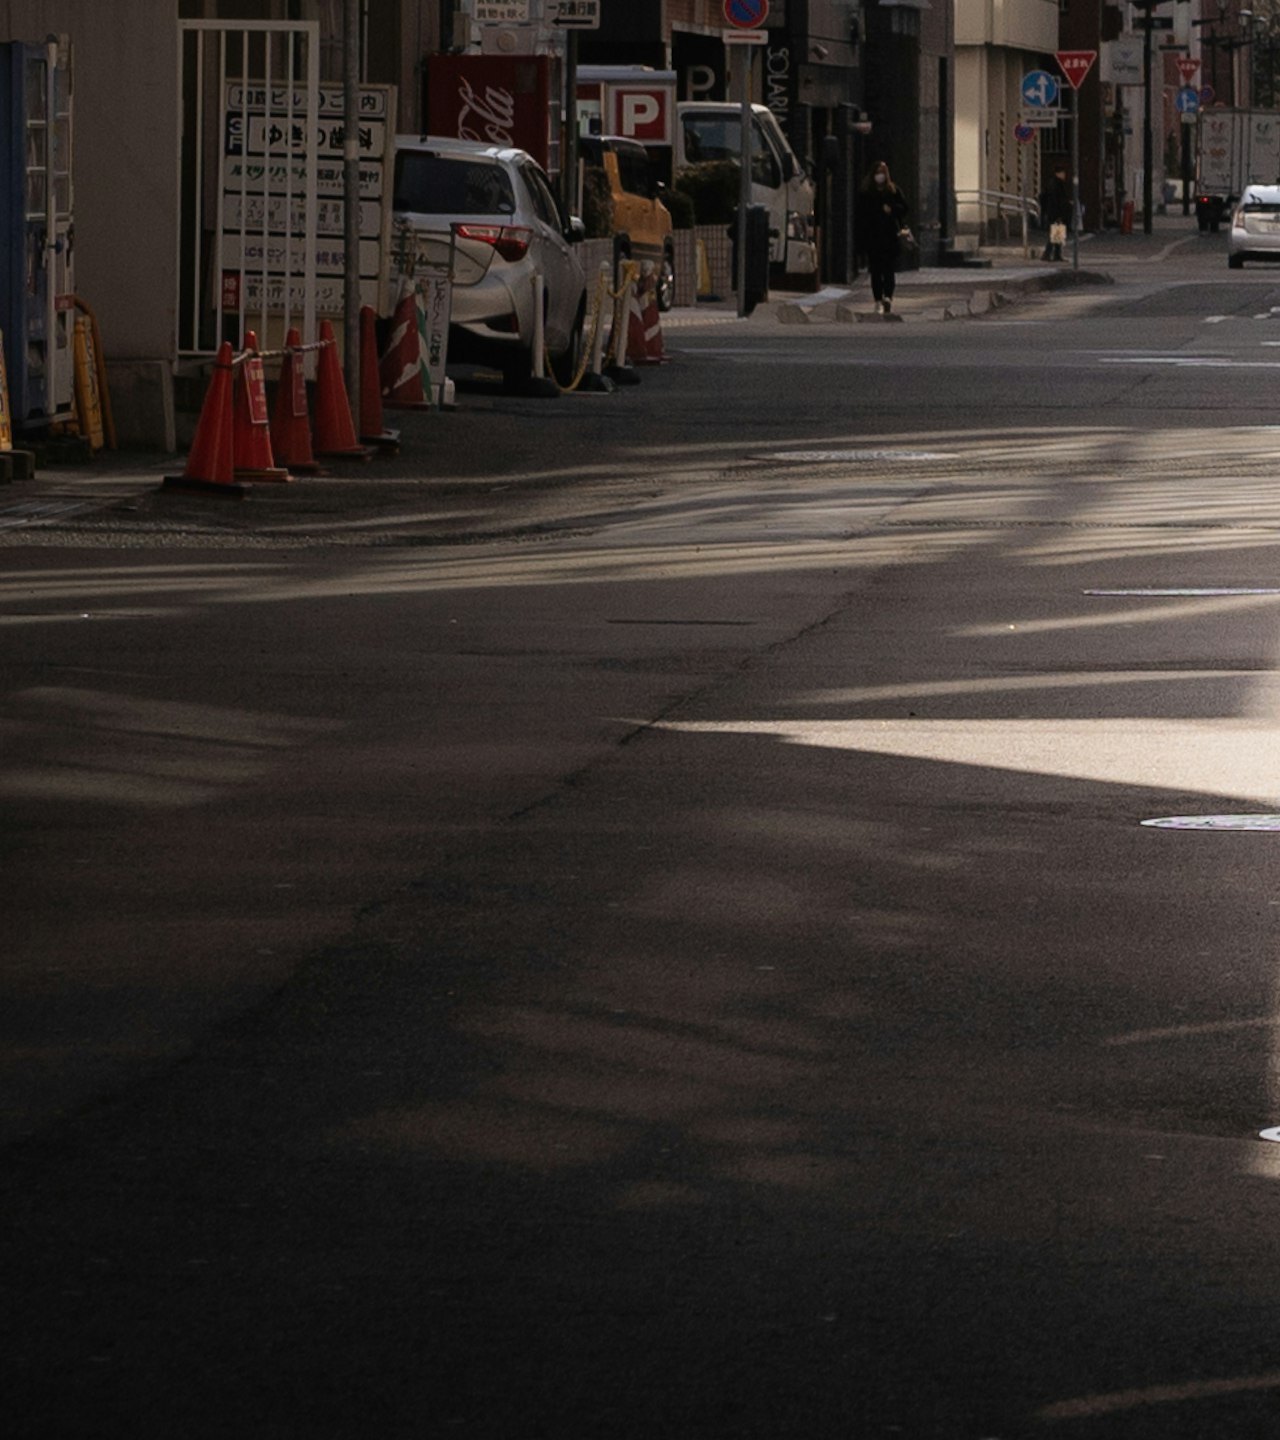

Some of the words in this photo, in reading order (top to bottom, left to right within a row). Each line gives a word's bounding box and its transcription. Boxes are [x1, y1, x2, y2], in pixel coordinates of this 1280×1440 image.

[547, 1, 597, 17] 一方通行路
[622, 93, 660, 136] P
